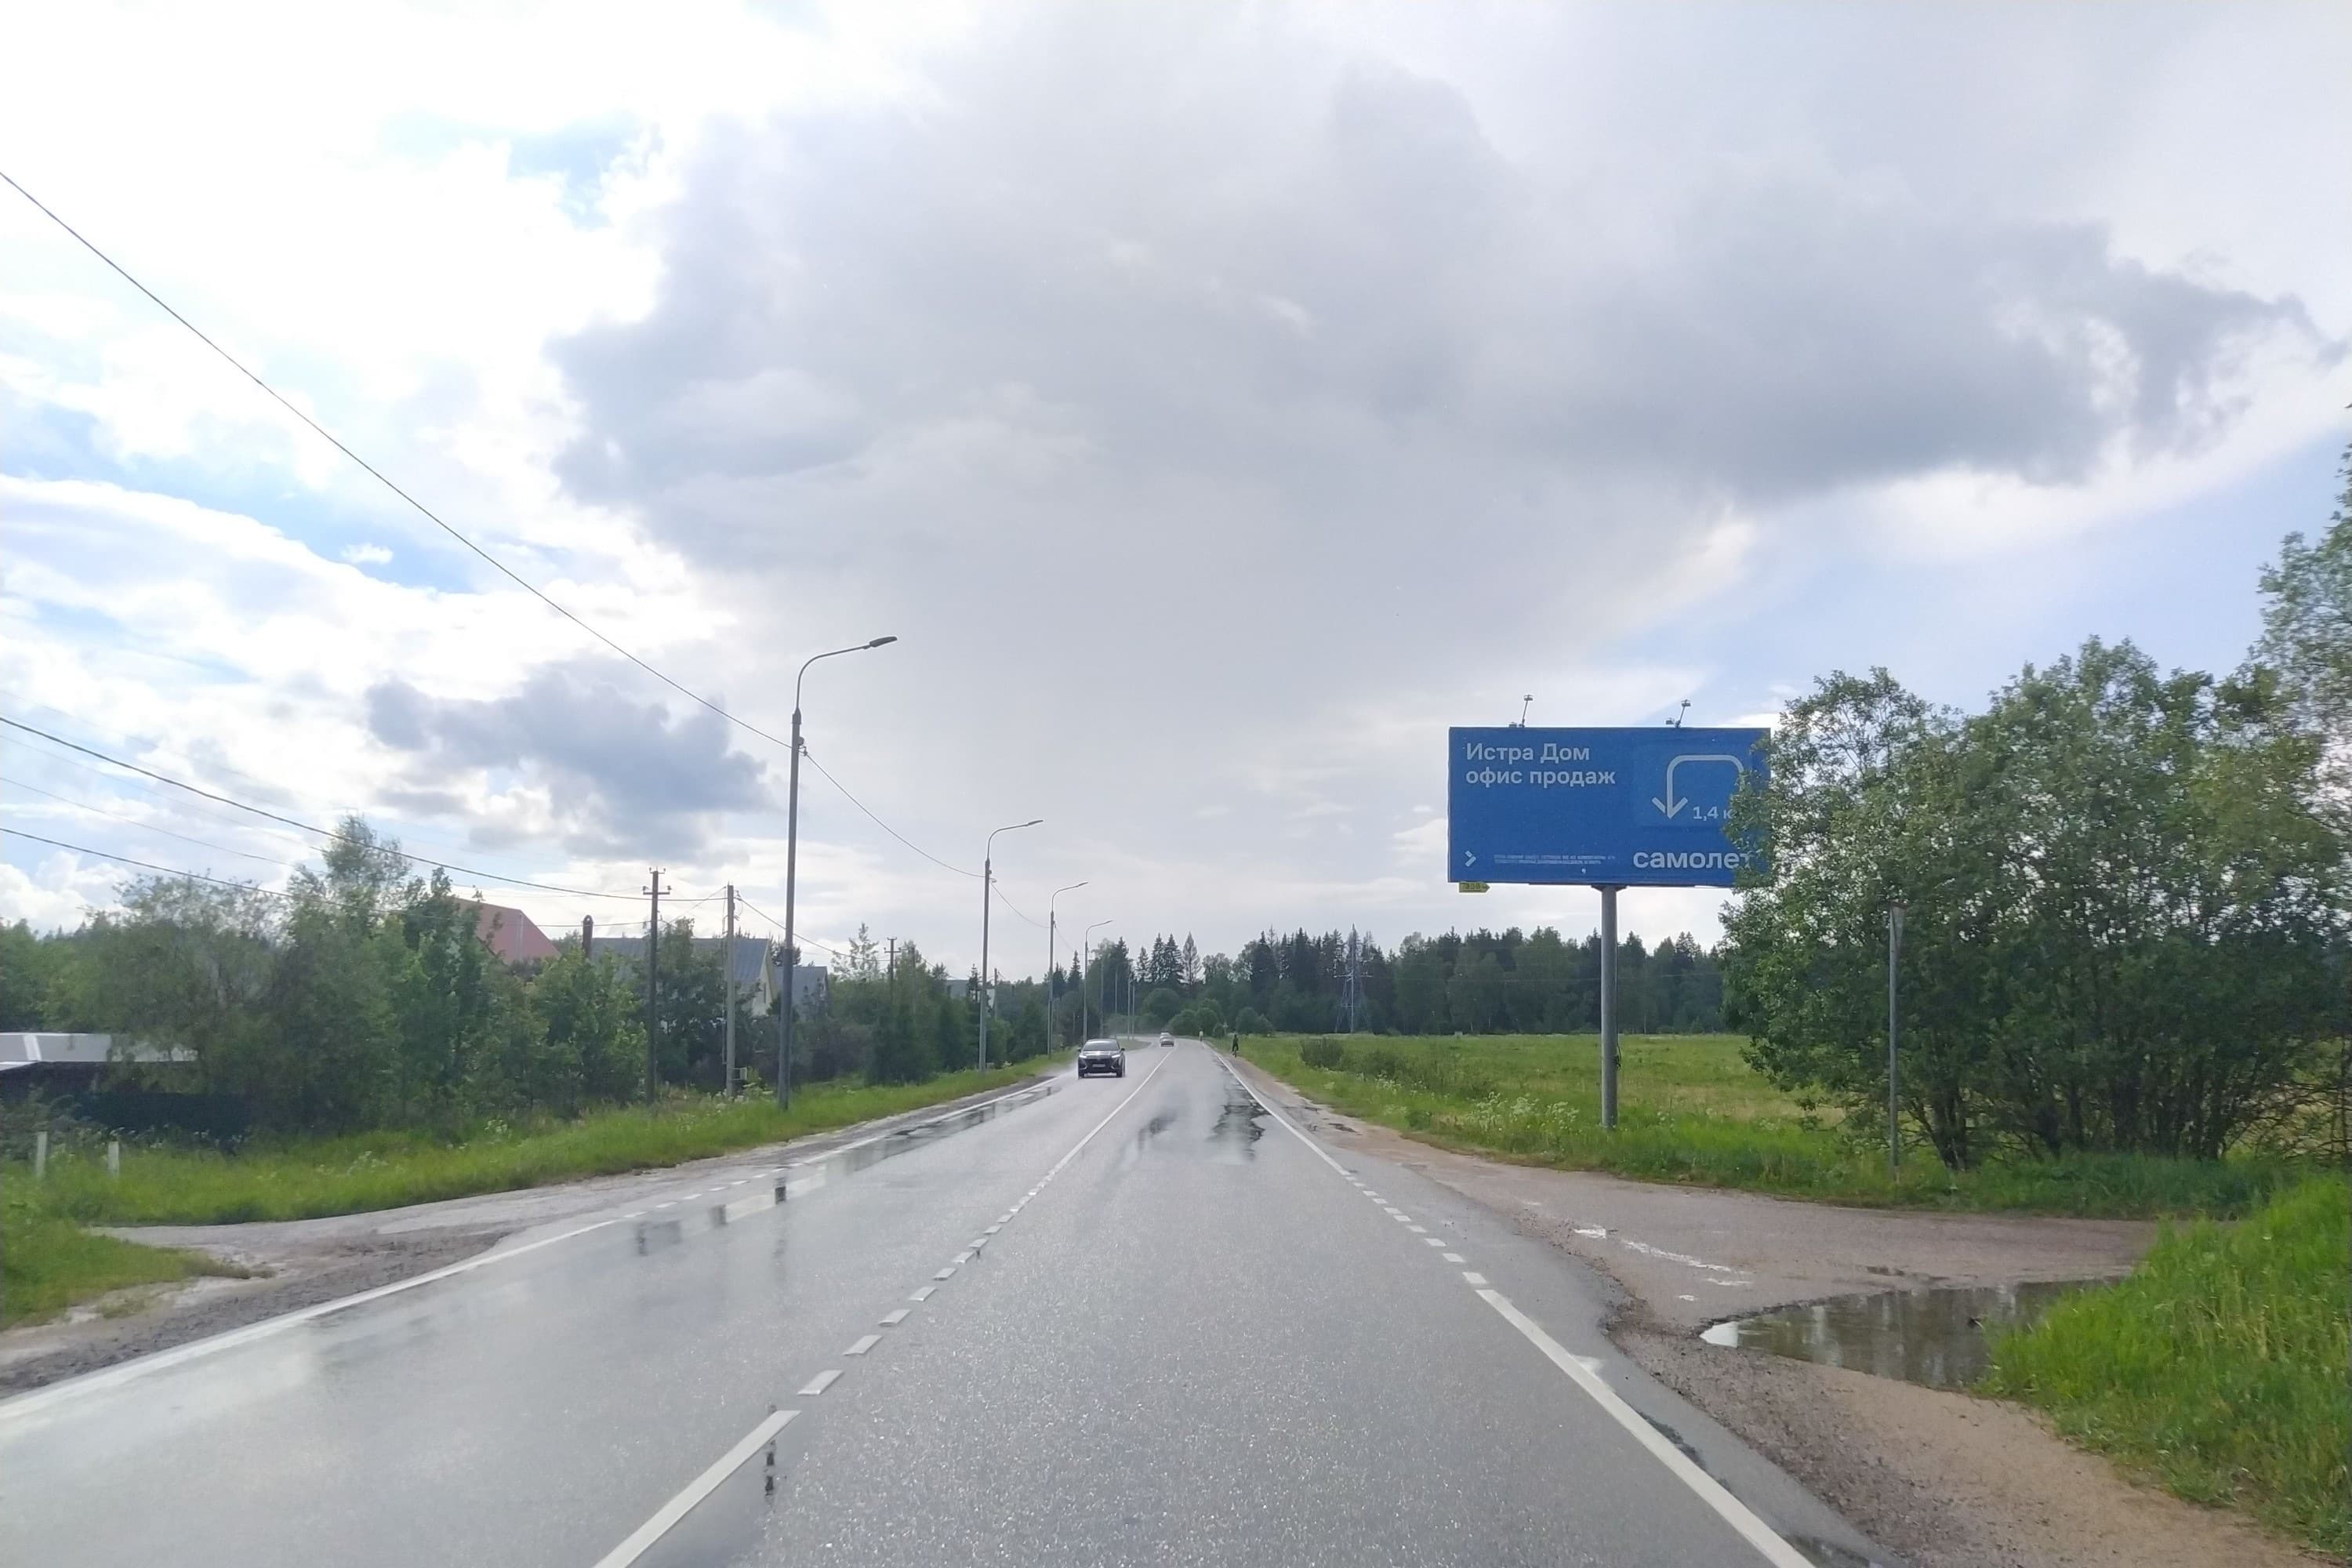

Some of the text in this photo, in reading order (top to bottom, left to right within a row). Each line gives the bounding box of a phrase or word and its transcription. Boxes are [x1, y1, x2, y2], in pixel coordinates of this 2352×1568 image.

[1466, 742, 1590, 765] Истра Дом
[1465, 767, 1616, 787] офис продаж
[1693, 806, 1719, 821] 1,4
